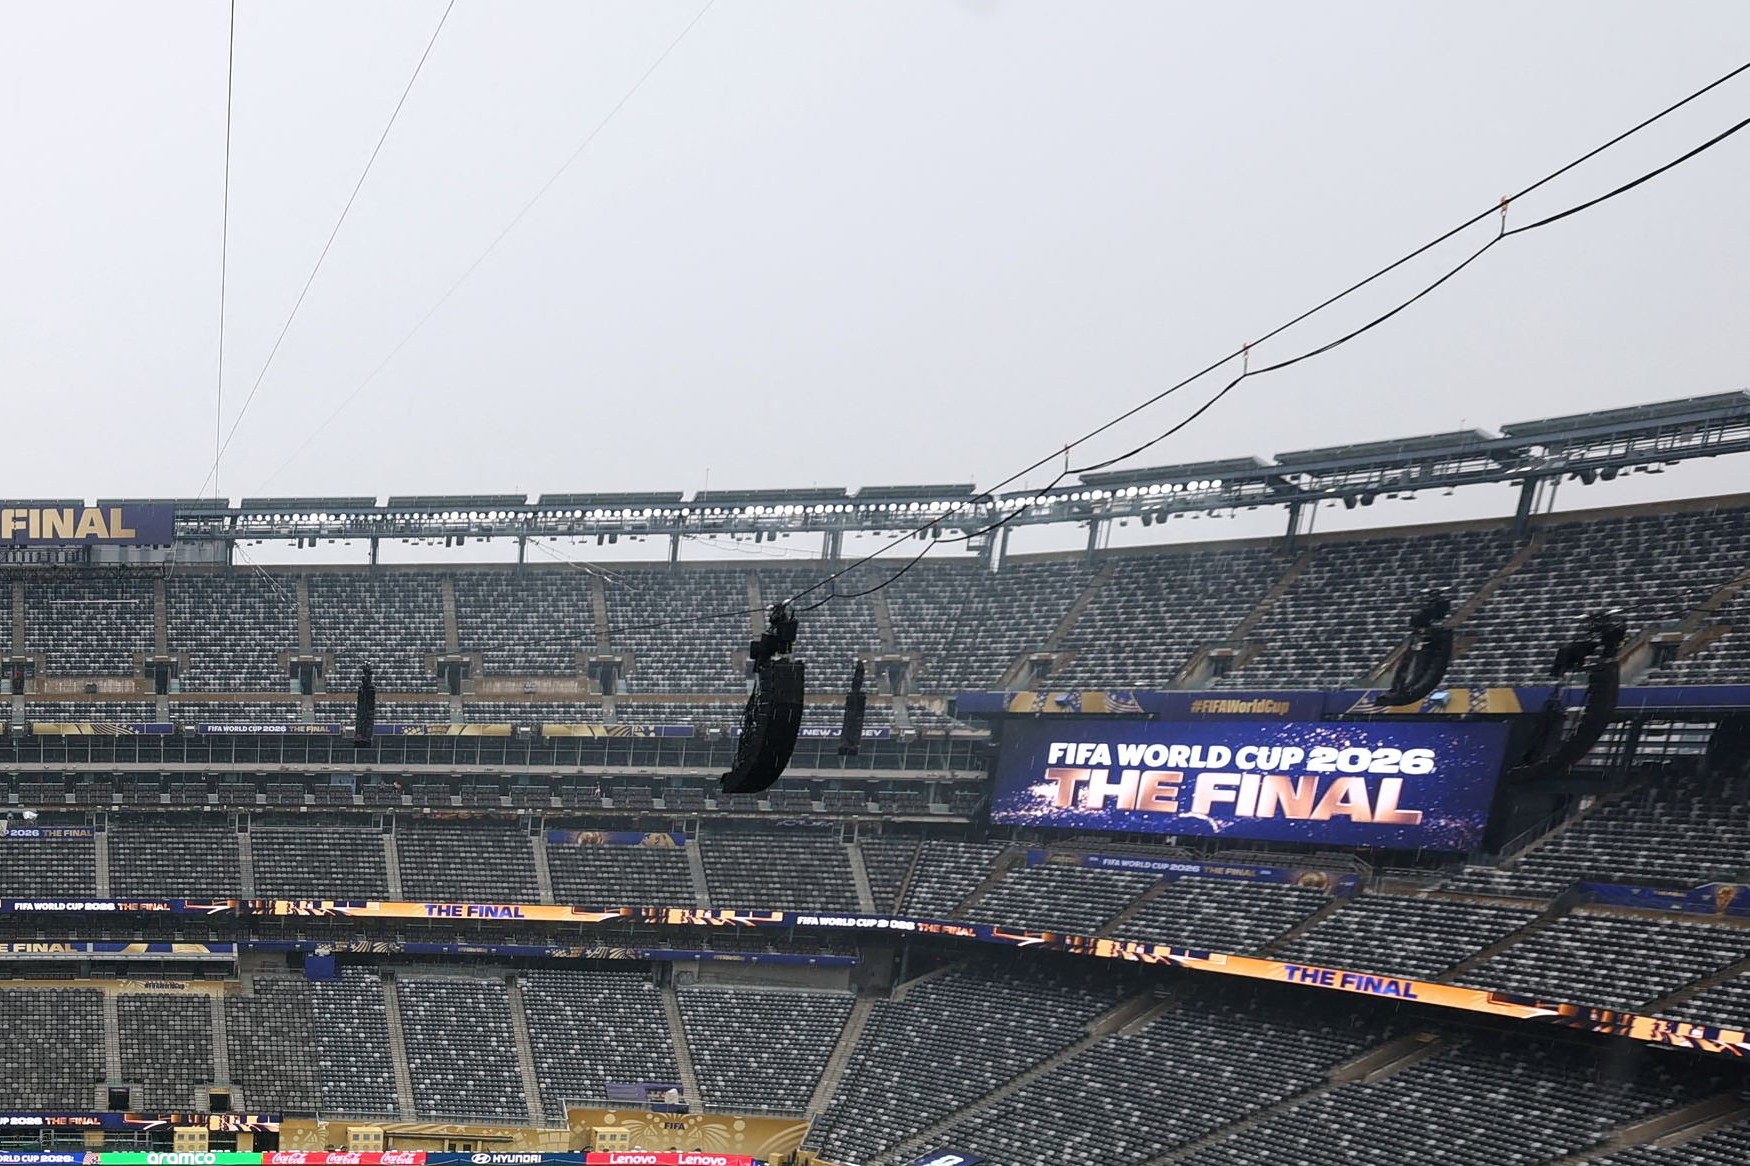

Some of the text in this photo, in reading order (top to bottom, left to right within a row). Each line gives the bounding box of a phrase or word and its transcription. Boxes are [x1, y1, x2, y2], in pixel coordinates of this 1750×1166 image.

[1, 508, 136, 539] FINAL
[1190, 699, 1290, 716] #FIFAWorldCup
[1048, 742, 1436, 775] FIFA WORLD CUP 2026
[1045, 767, 1423, 825] THE FINAL
[11, 829, 40, 837] 2026
[42, 829, 61, 837] THE
[63, 829, 93, 837] FINAL
[1103, 857, 1120, 866] FIFA
[1121, 859, 1151, 869] WORLD
[1152, 862, 1169, 871] CUP
[1169, 863, 1200, 872] 2026
[1203, 866, 1224, 875] THE
[1226, 867, 1256, 877] FINAL
[425, 905, 524, 918] THE FINAL
[797, 916, 819, 925] FIFA
[819, 917, 855, 926] WORLD
[856, 918, 877, 927] CUP
[917, 923, 940, 933] THE
[944, 925, 976, 937] FINAL
[13, 943, 79, 952] FINAL
[1284, 965, 1418, 999] THE FINAL
[10, 1117, 42, 1126] 2026
[45, 1117, 68, 1125] THE
[70, 1117, 100, 1125] FINAL
[664, 1121, 685, 1130] FIFA
[23, 1154, 40, 1163] CUP
[40, 1154, 72, 1163] 2026
[147, 1152, 216, 1165] aramco
[272, 1153, 308, 1165] Coca-Cola
[326, 1153, 362, 1165] Coca-Cola
[380, 1153, 416, 1165] Coca-Cola
[492, 1154, 541, 1164] HYUNDAI
[609, 1153, 656, 1165] Lenovo
[678, 1154, 727, 1166] Lenovo
